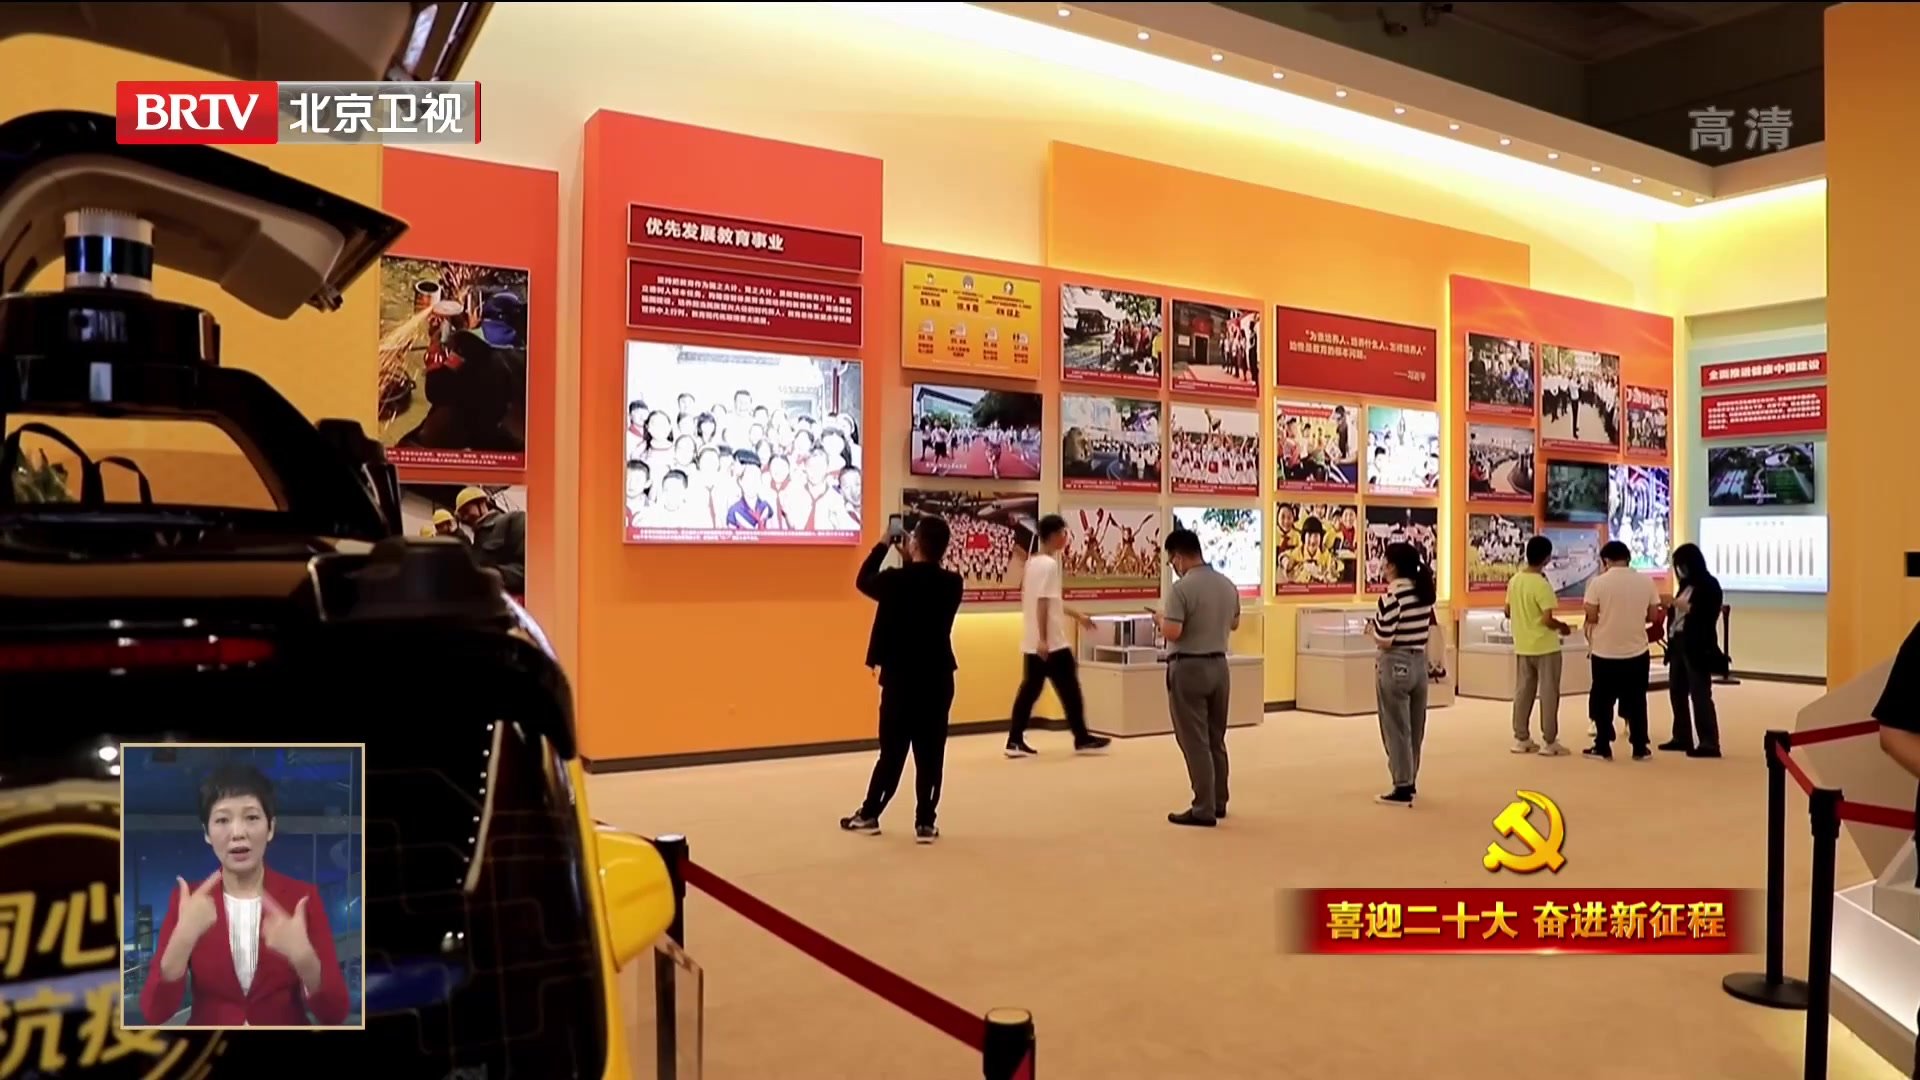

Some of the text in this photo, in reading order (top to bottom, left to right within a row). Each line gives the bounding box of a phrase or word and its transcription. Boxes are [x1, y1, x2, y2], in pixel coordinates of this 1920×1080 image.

[645, 217, 784, 251] 优先发展教育事业
